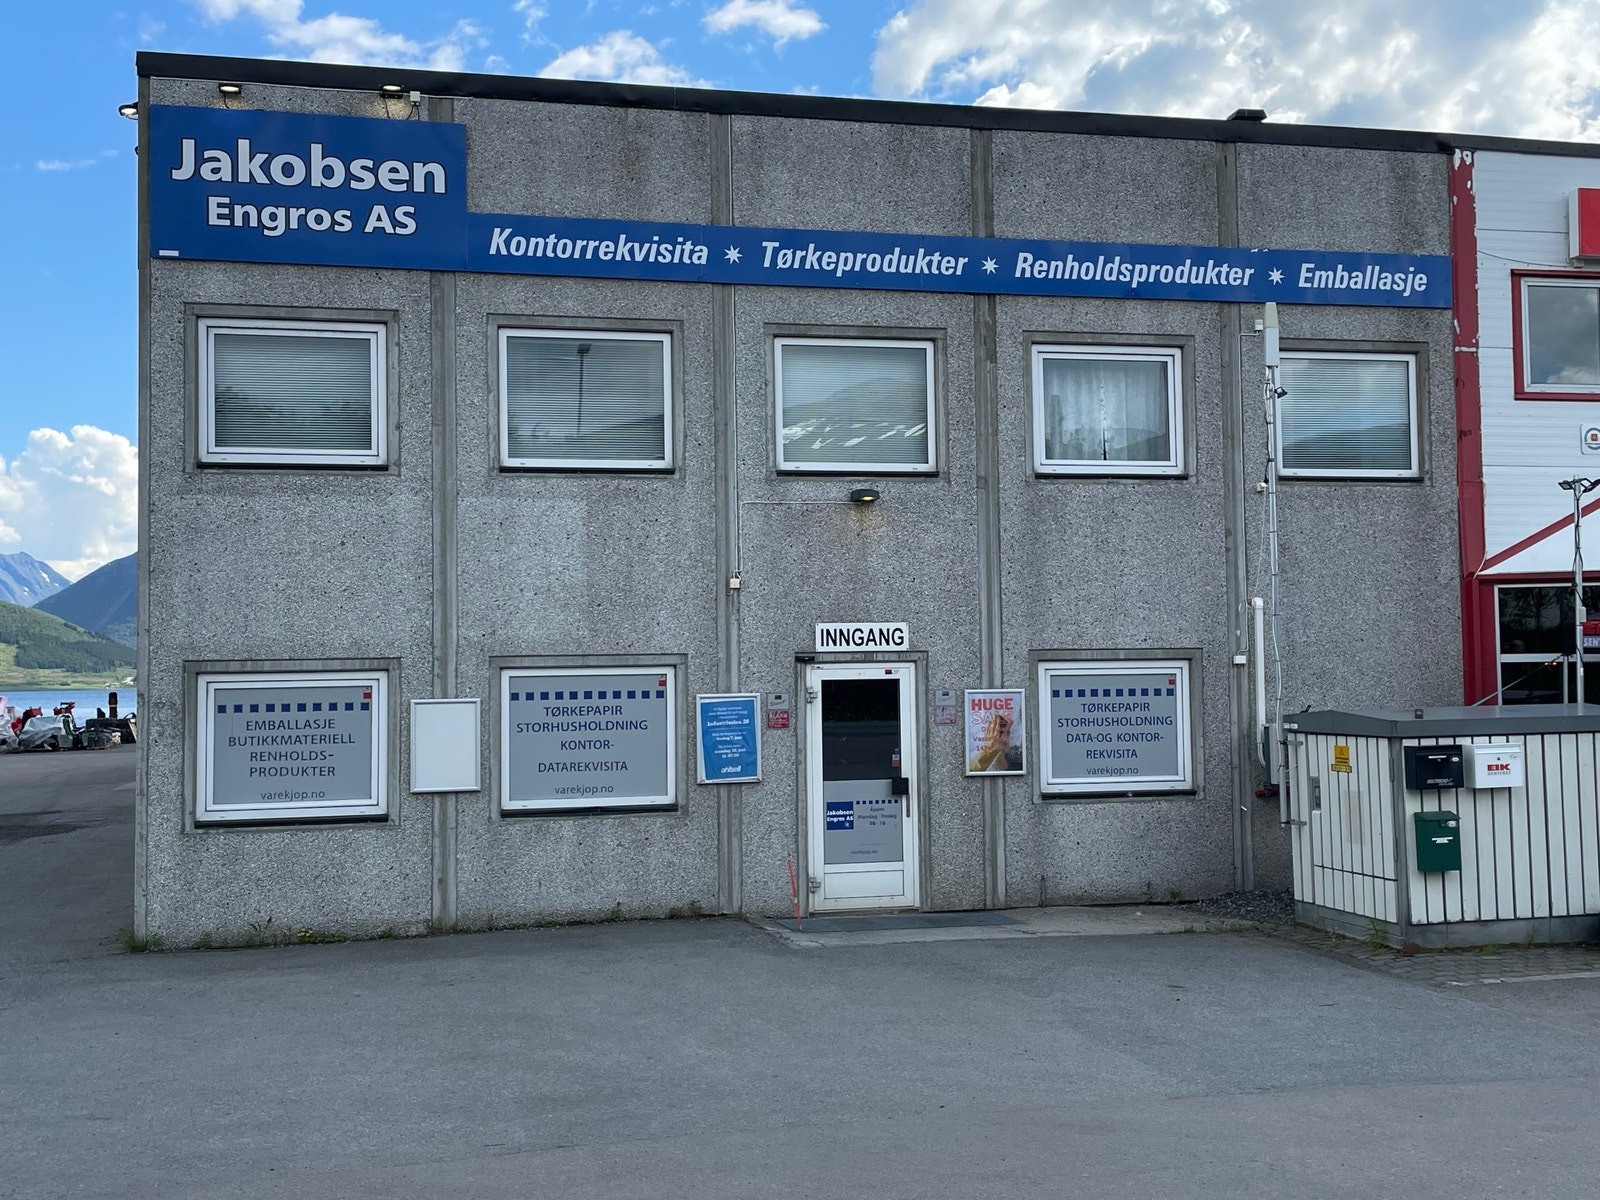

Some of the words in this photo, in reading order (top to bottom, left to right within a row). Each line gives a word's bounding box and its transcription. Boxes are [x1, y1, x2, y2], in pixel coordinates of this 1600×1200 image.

[170, 138, 447, 194] Jakobsen
[207, 196, 353, 238] Engros
[363, 204, 418, 236] AS
[489, 227, 710, 266] Kontorrekvisita
[761, 241, 969, 280] Tørkeprodukter
[1014, 252, 1255, 289] Renholdsprodukter
[1298, 263, 1428, 297] Emballasje
[820, 628, 905, 647] INNGANG
[971, 698, 1014, 711] HUGE
[1081, 702, 1151, 713] TØRKEPAPIR
[543, 705, 623, 717] TØRKEPAPIR
[246, 718, 336, 731] EMBALLASJE
[516, 720, 649, 733] STORHUSHOLDNING
[1057, 716, 1173, 728] STORHUSHOLDNING
[228, 733, 356, 747] BUTIKKMATERIELL
[1066, 733, 1113, 743] DATA-OG
[1117, 732, 1164, 743] KONTOR-
[560, 740, 615, 751] KONTOR-
[250, 750, 334, 762] RENHOLDS-
[1086, 749, 1138, 760] REKVISITA
[249, 766, 336, 777] PRODUKTER
[538, 761, 629, 773] DATAREKVISITA
[1086, 766, 1139, 776] varekjop.no
[1487, 764, 1511, 772] EIK
[260, 790, 326, 802] varekjop.no
[555, 784, 614, 796] varekjop.no
